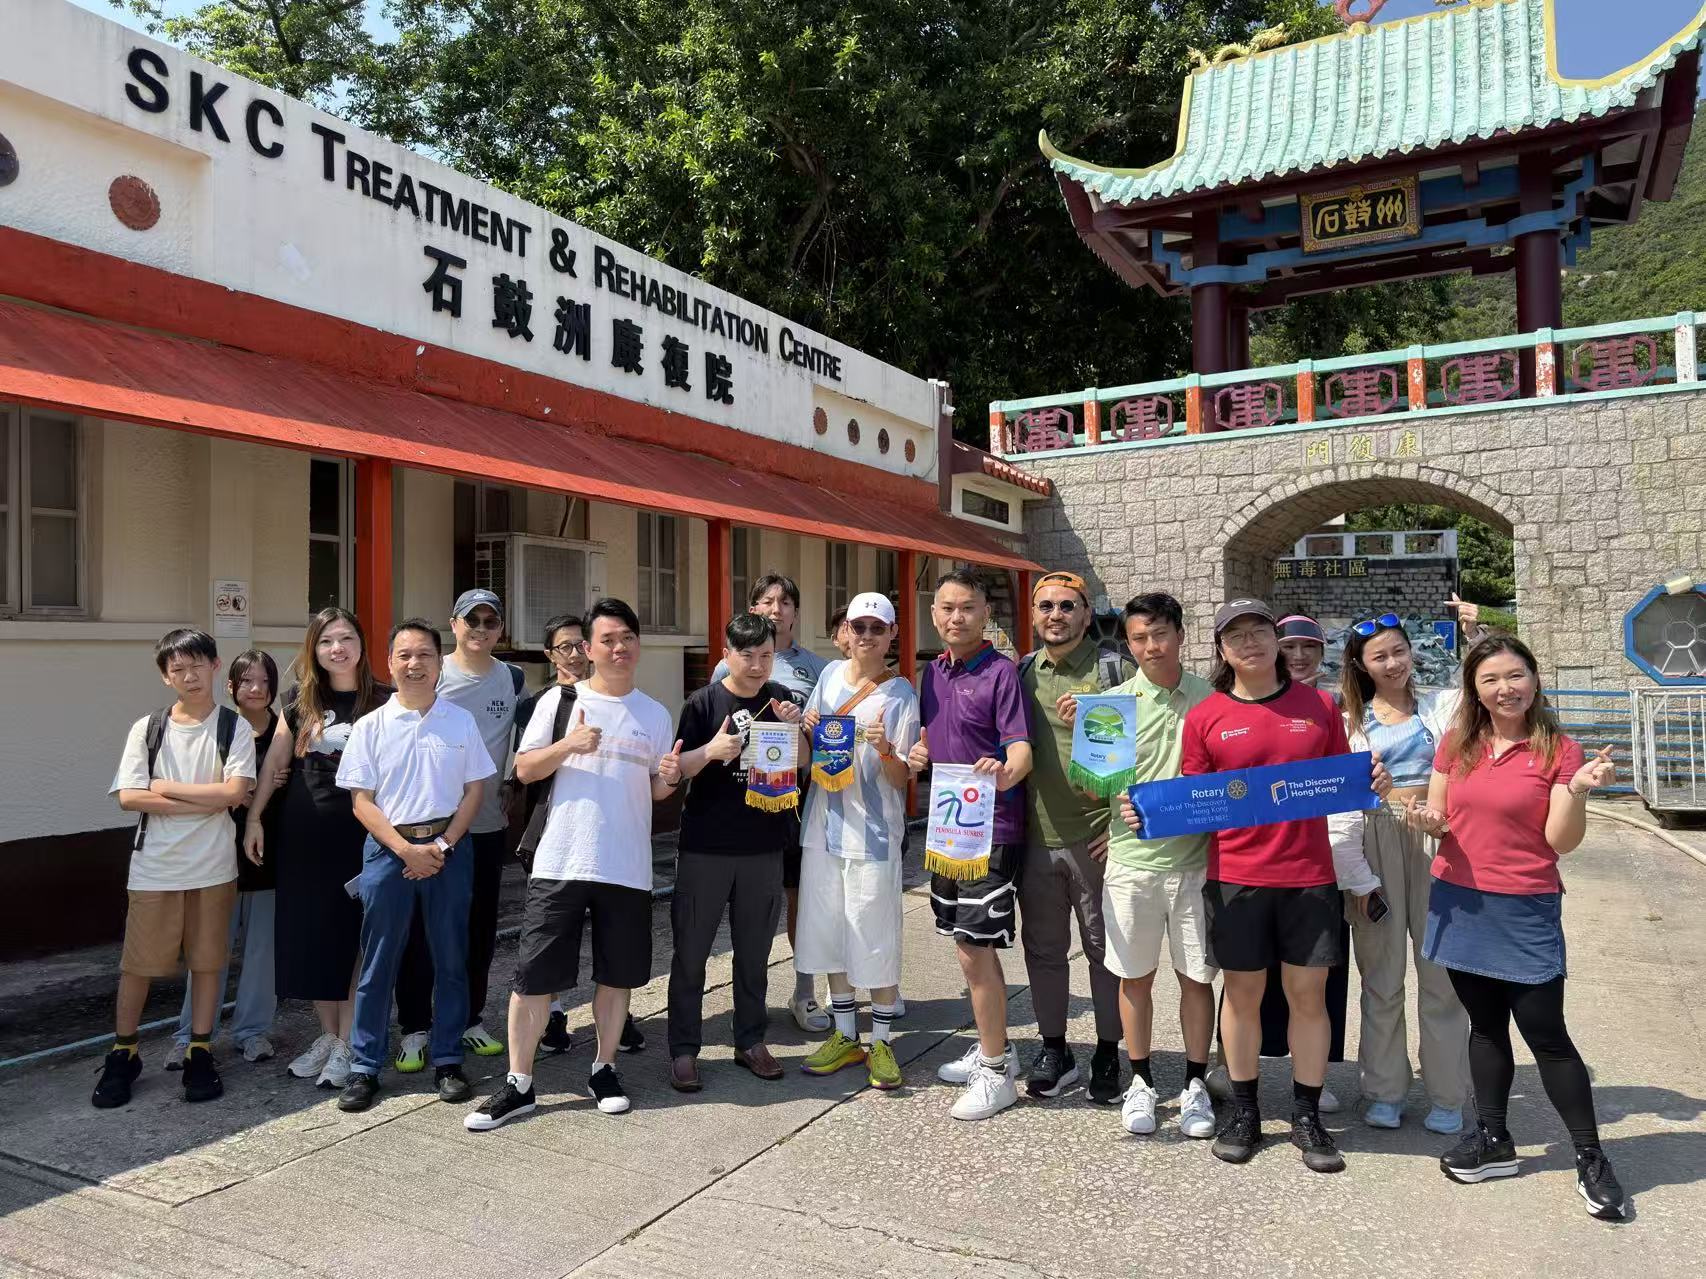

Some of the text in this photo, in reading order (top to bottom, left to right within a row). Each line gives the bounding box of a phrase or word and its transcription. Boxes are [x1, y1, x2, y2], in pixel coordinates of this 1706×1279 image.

[311, 122, 531, 257] TREATMENT
[550, 228, 577, 278] &
[594, 245, 768, 353] REHABILITATION
[779, 327, 841, 382] CENTRE
[423, 245, 734, 405] 石鼓洲康復院
[1274, 559, 1367, 580] 無毒社區
[1288, 776, 1345, 790] The Discovery
[1191, 787, 1225, 799] Rotary
[1291, 785, 1338, 797] Hong Kong
[1160, 804, 1175, 812] Club
[1197, 800, 1227, 808] Discovery
[1192, 806, 1229, 816] Hong Kong
